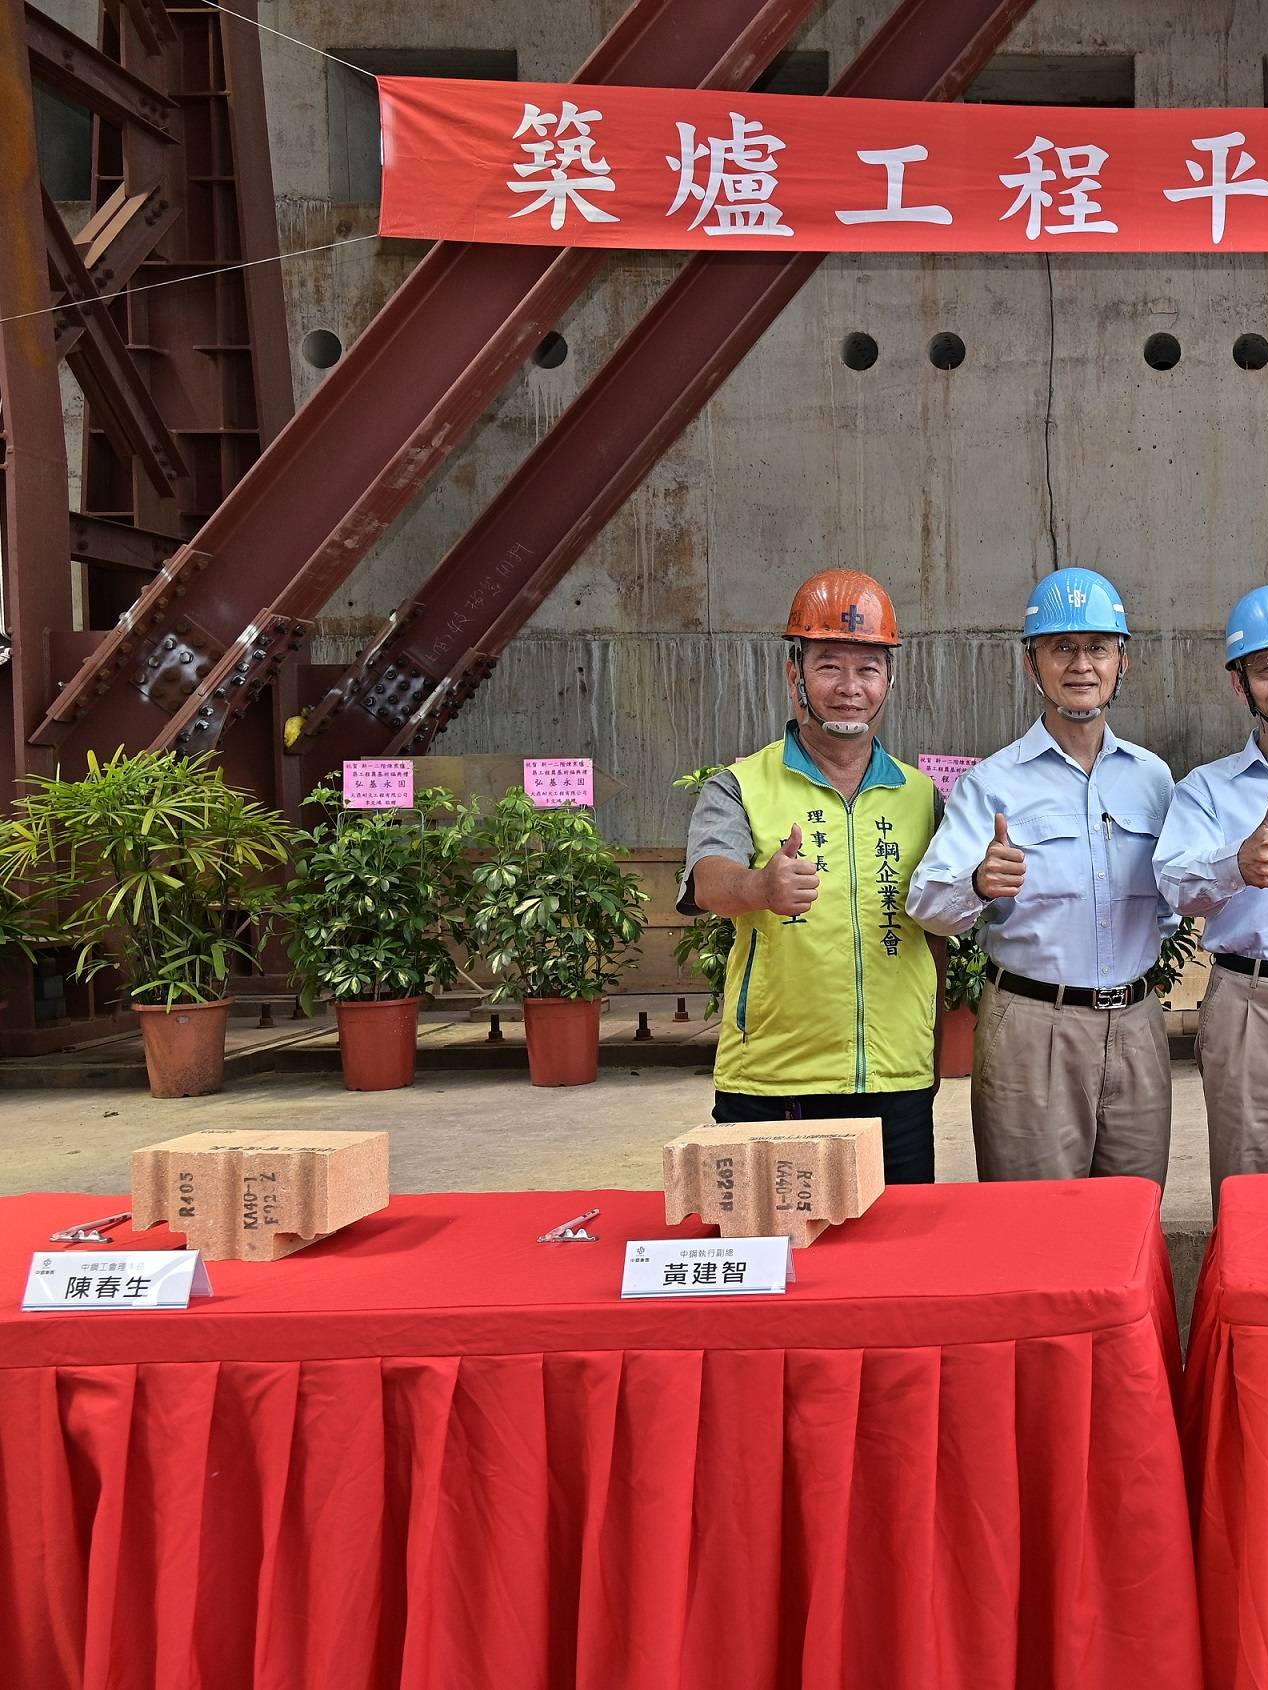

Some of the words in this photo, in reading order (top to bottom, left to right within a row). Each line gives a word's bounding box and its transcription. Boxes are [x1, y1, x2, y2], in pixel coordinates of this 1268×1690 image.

[355, 779, 406, 789] 弘基永固
[534, 778, 585, 787] 弘基永固
[806, 809, 830, 873] 理事長
[874, 815, 903, 957] 中鋼企業工會
[179, 1171, 196, 1218] R405
[679, 1248, 735, 1259] 中鋼執行副總
[662, 1260, 747, 1286] 黃建智
[64, 1275, 152, 1300] 陳春生
